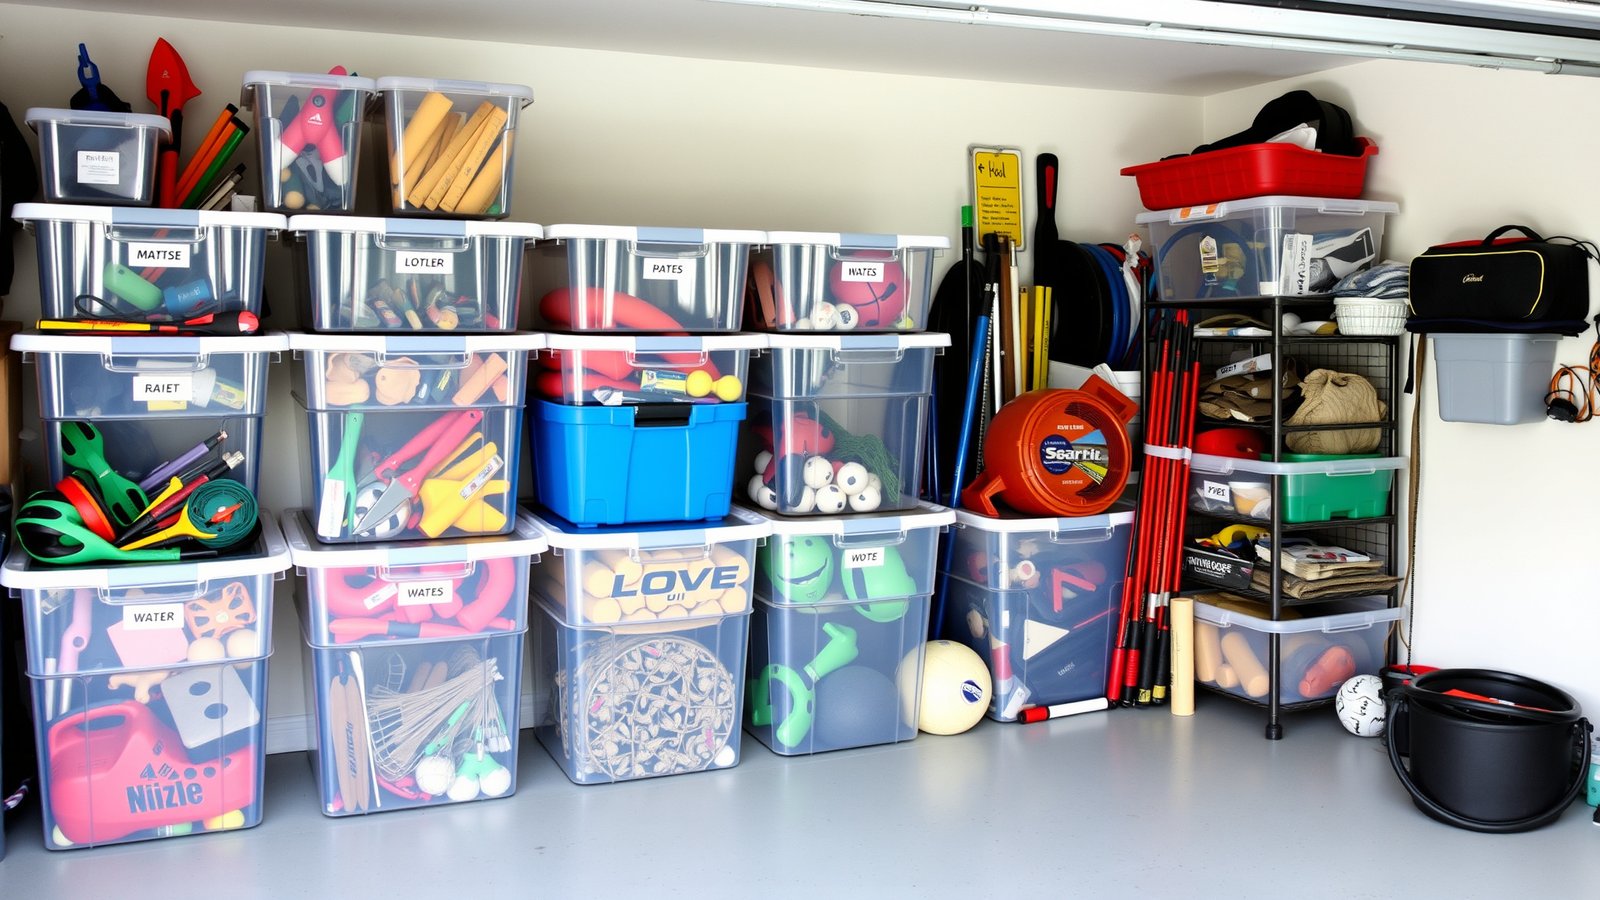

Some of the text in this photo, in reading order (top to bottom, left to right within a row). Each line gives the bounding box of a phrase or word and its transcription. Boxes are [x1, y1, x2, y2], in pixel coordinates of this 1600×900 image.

[137, 250, 182, 260] MATTSE
[405, 257, 444, 267] LOTLER
[652, 264, 683, 274] PATES
[145, 383, 180, 393] RAIET
[851, 552, 878, 562] WOTE
[611, 565, 740, 598] LOVE
[407, 587, 444, 598] WATES
[134, 611, 175, 622] WATER
